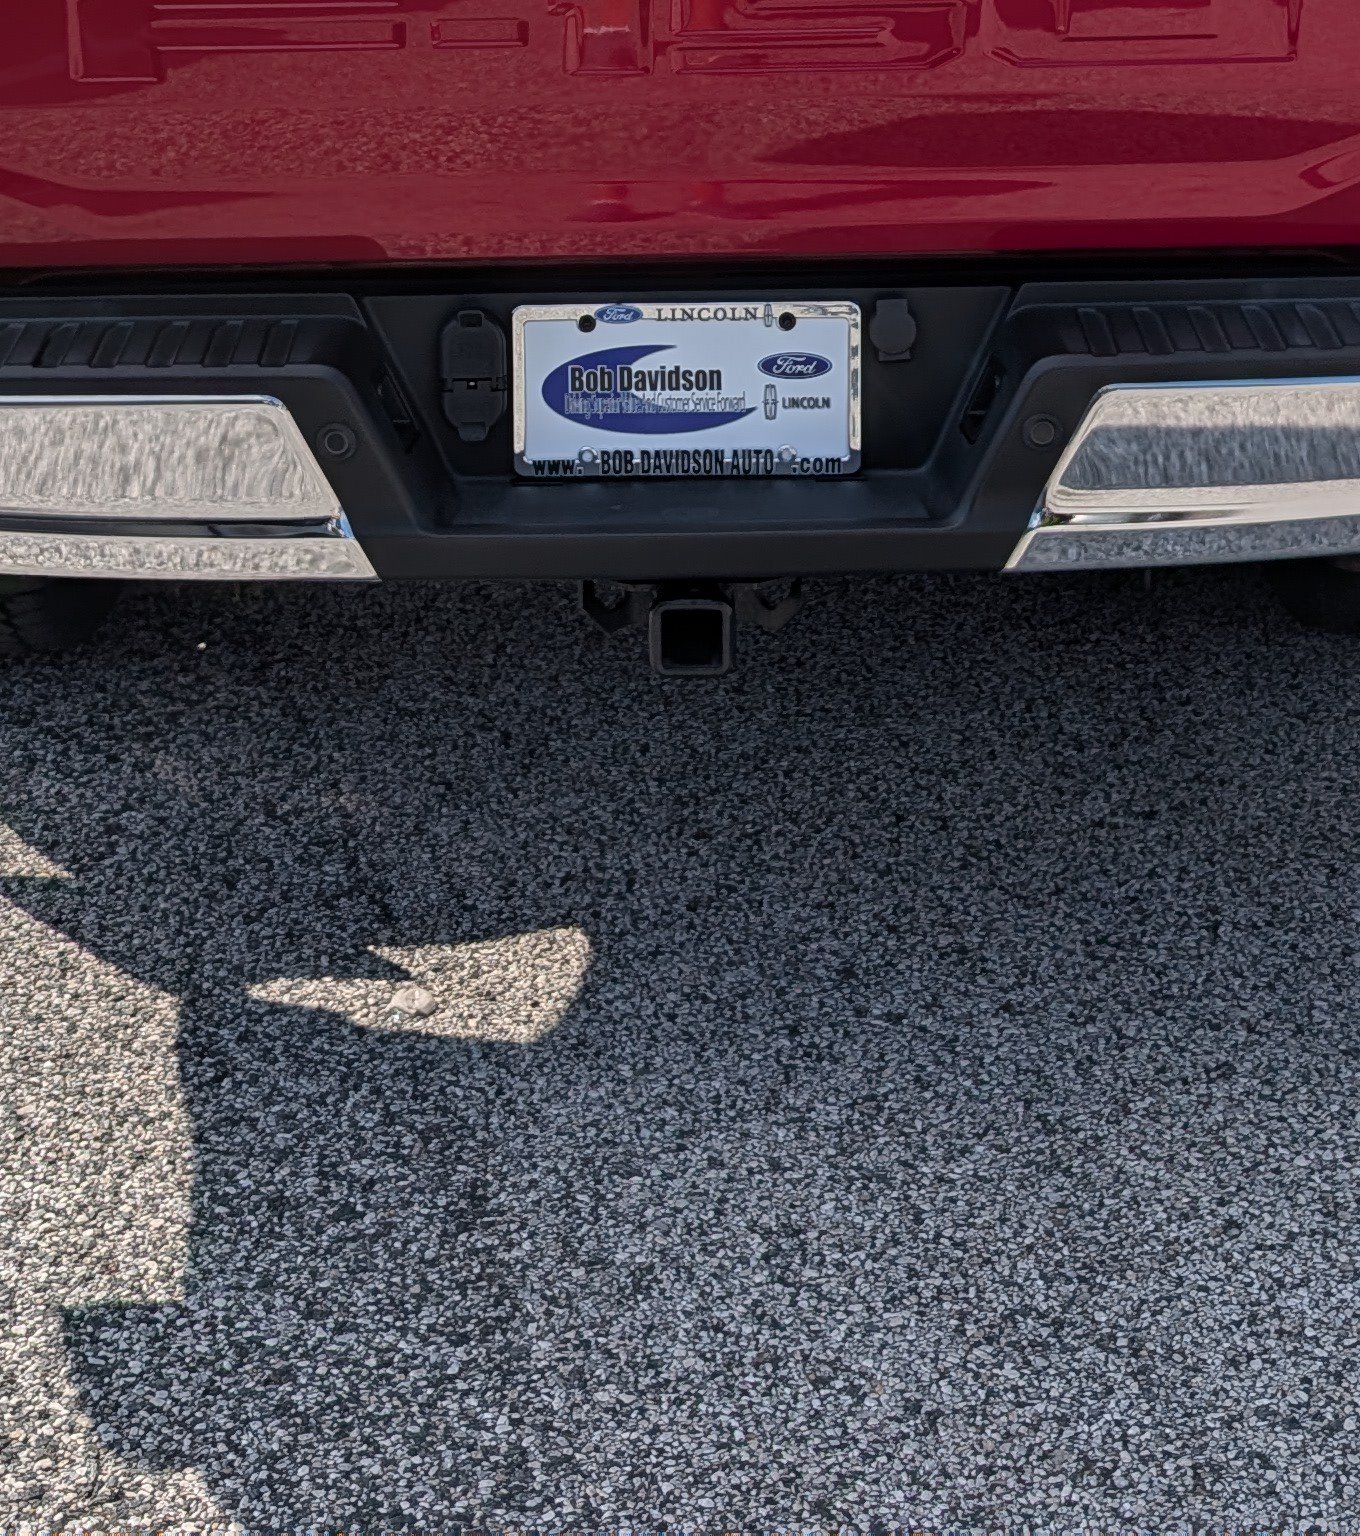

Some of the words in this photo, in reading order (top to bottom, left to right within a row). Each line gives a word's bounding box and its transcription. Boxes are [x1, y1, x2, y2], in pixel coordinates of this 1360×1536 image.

[602, 306, 634, 322] Ford
[655, 307, 759, 322] LINCOLN
[772, 356, 818, 374] Ford
[569, 364, 615, 393] Bob
[618, 365, 723, 392] Davidson
[781, 396, 831, 410] LINCOLN
[600, 449, 634, 475] BOB
[640, 449, 725, 475] DAVIDSON
[731, 449, 774, 475] AUTO
